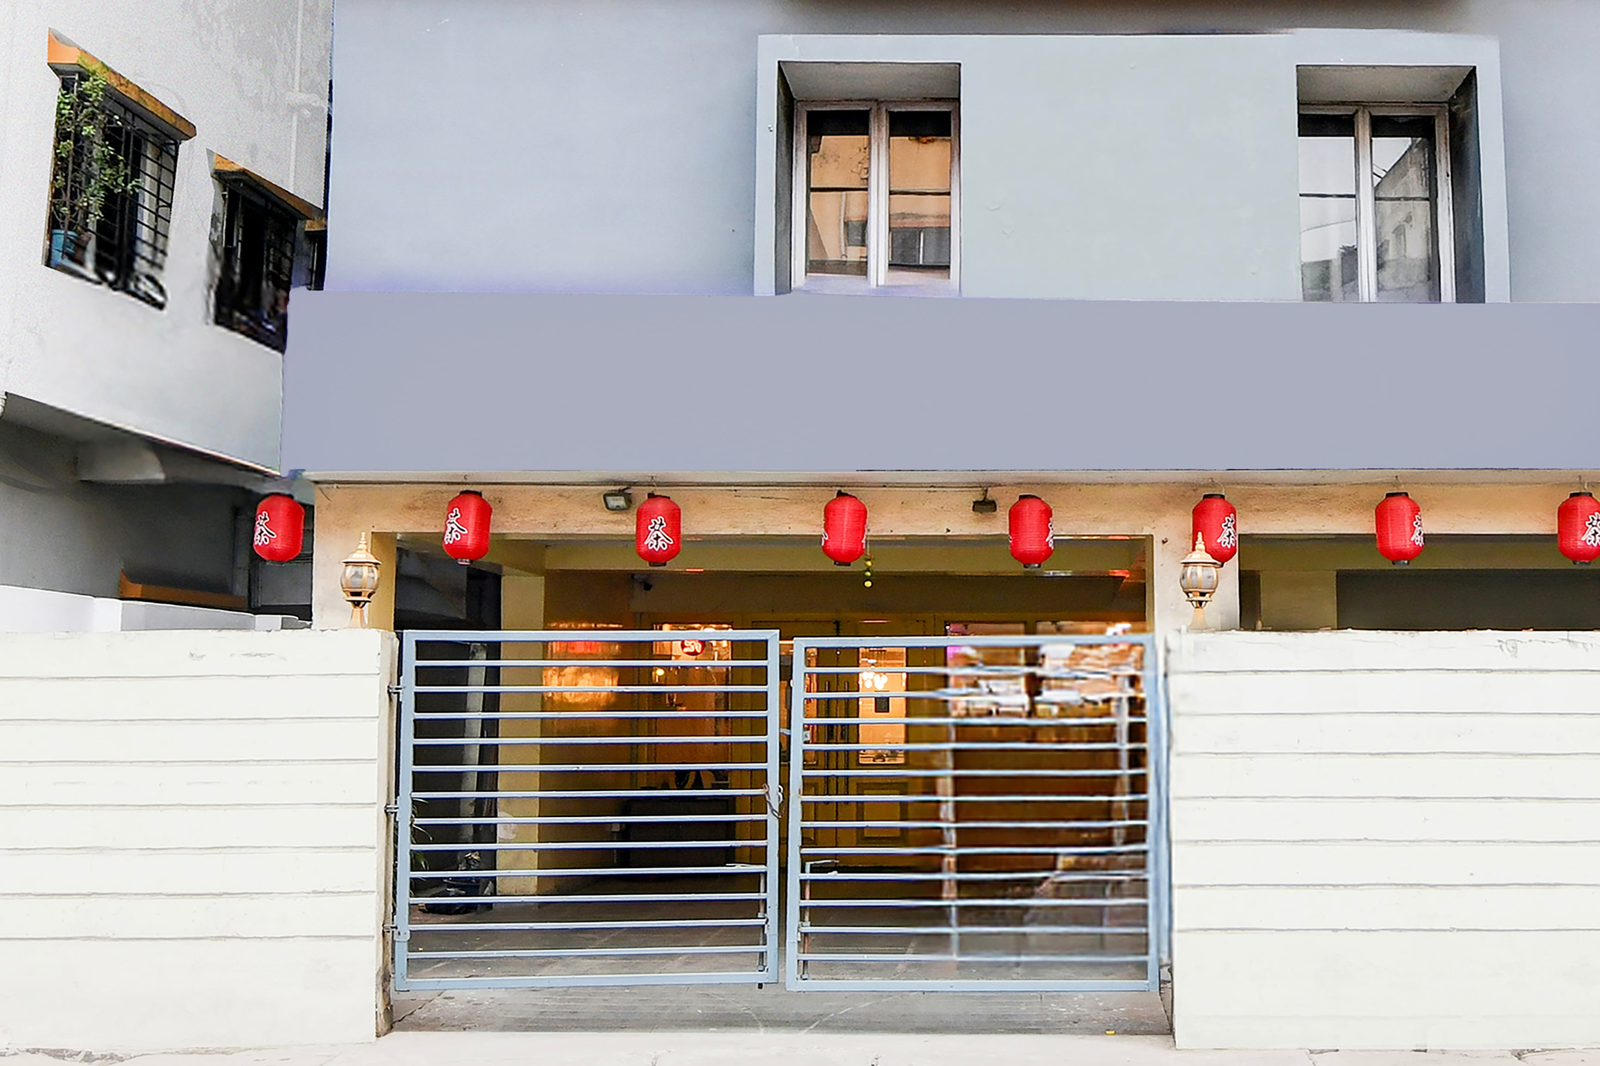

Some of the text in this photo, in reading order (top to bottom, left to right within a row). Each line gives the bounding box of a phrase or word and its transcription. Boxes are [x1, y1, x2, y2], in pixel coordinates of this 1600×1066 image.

[254, 511, 276, 546] 茶
[444, 507, 467, 544] 茶
[644, 515, 673, 551] 茶
[1216, 512, 1236, 548] 茶
